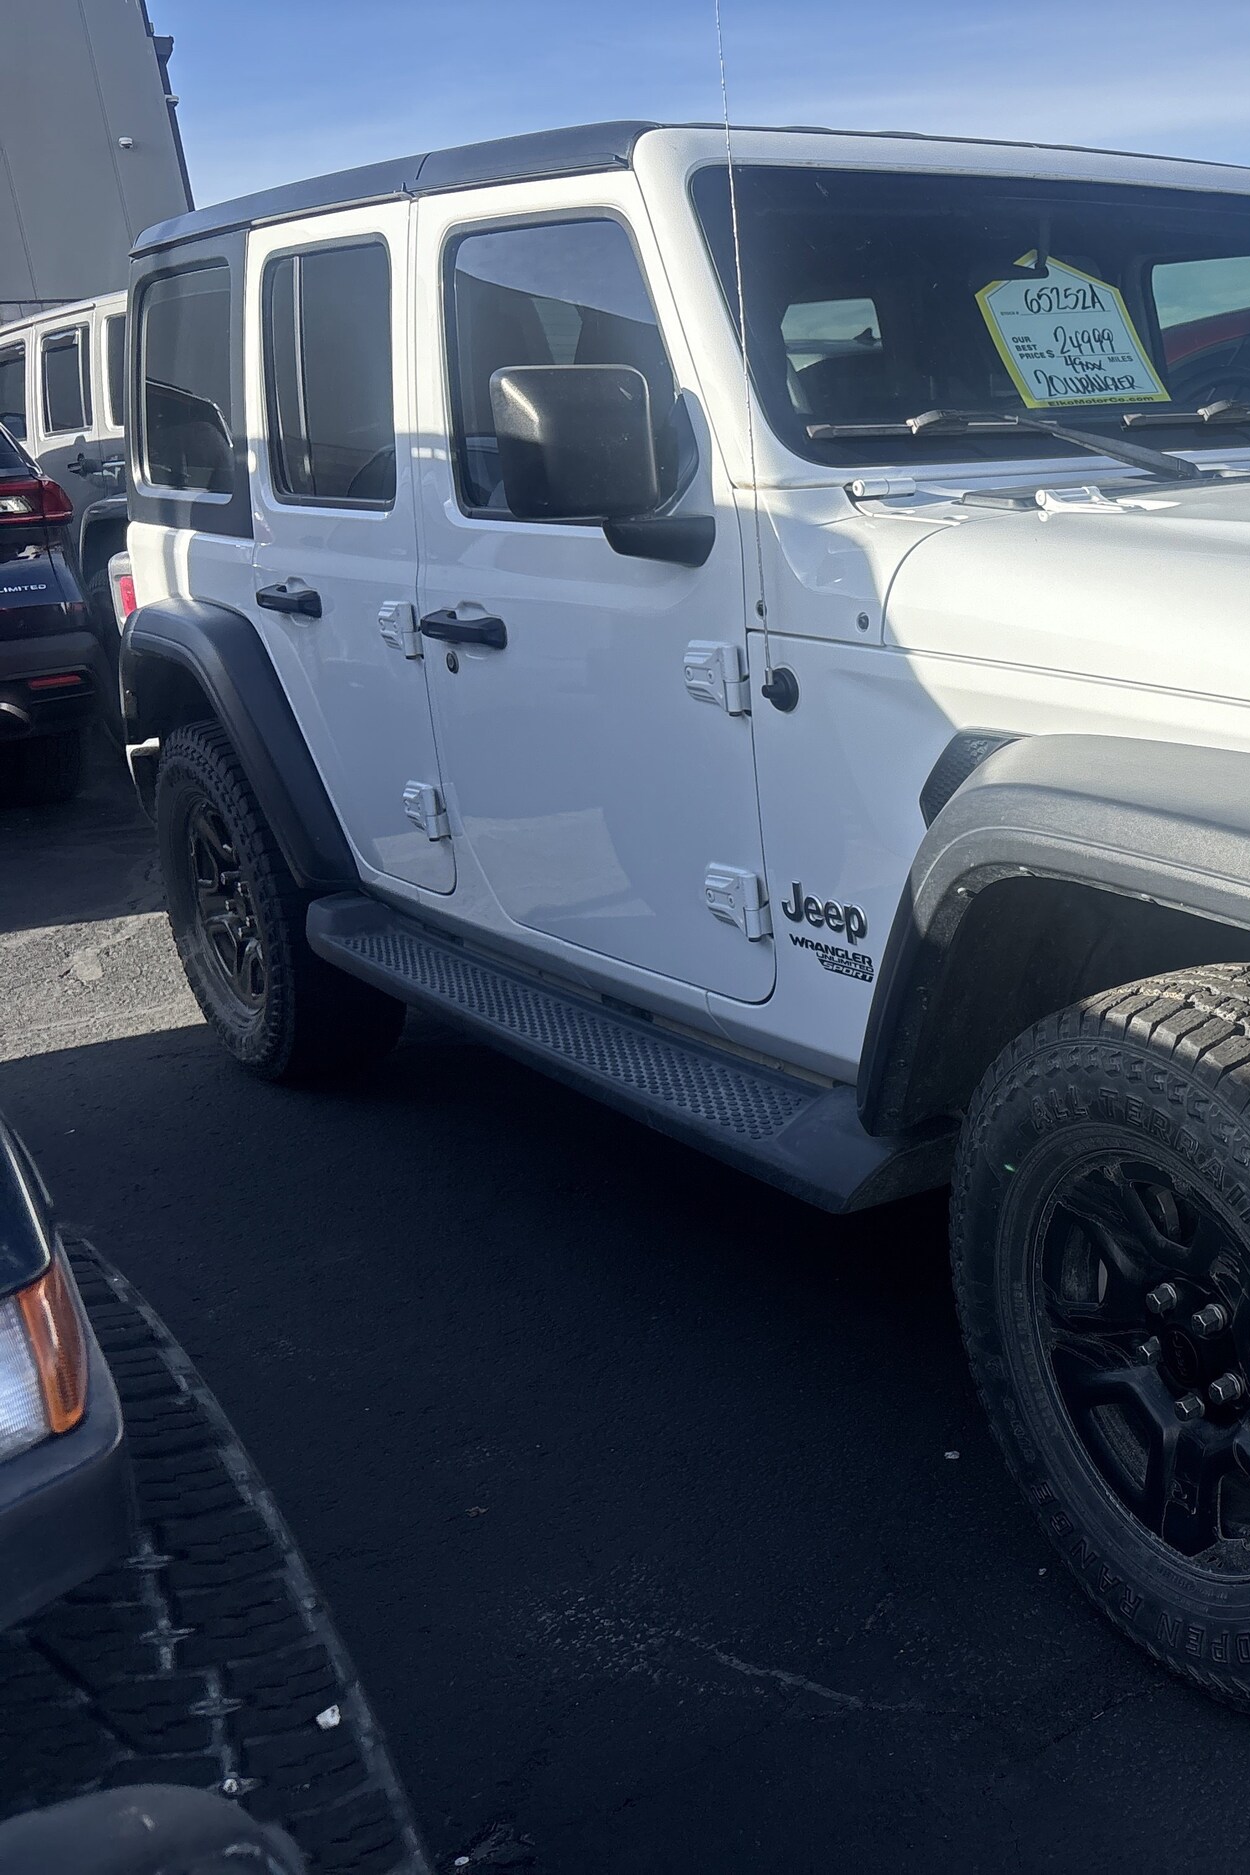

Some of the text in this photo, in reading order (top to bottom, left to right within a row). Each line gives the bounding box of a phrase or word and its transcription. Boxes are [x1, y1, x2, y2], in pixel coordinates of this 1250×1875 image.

[1024, 284, 1106, 313] 65252A
[1011, 336, 1032, 344] OUR
[1053, 325, 1114, 355] 24999
[1019, 352, 1046, 360] PRICE
[1107, 355, 1134, 363] MILES
[781, 880, 868, 946] Jeep
[789, 933, 873, 967] WRANGLER
[816, 951, 874, 973] UNLIMITED
[823, 961, 874, 981] SPORT
[1030, 1479, 1145, 1622] RANGE
